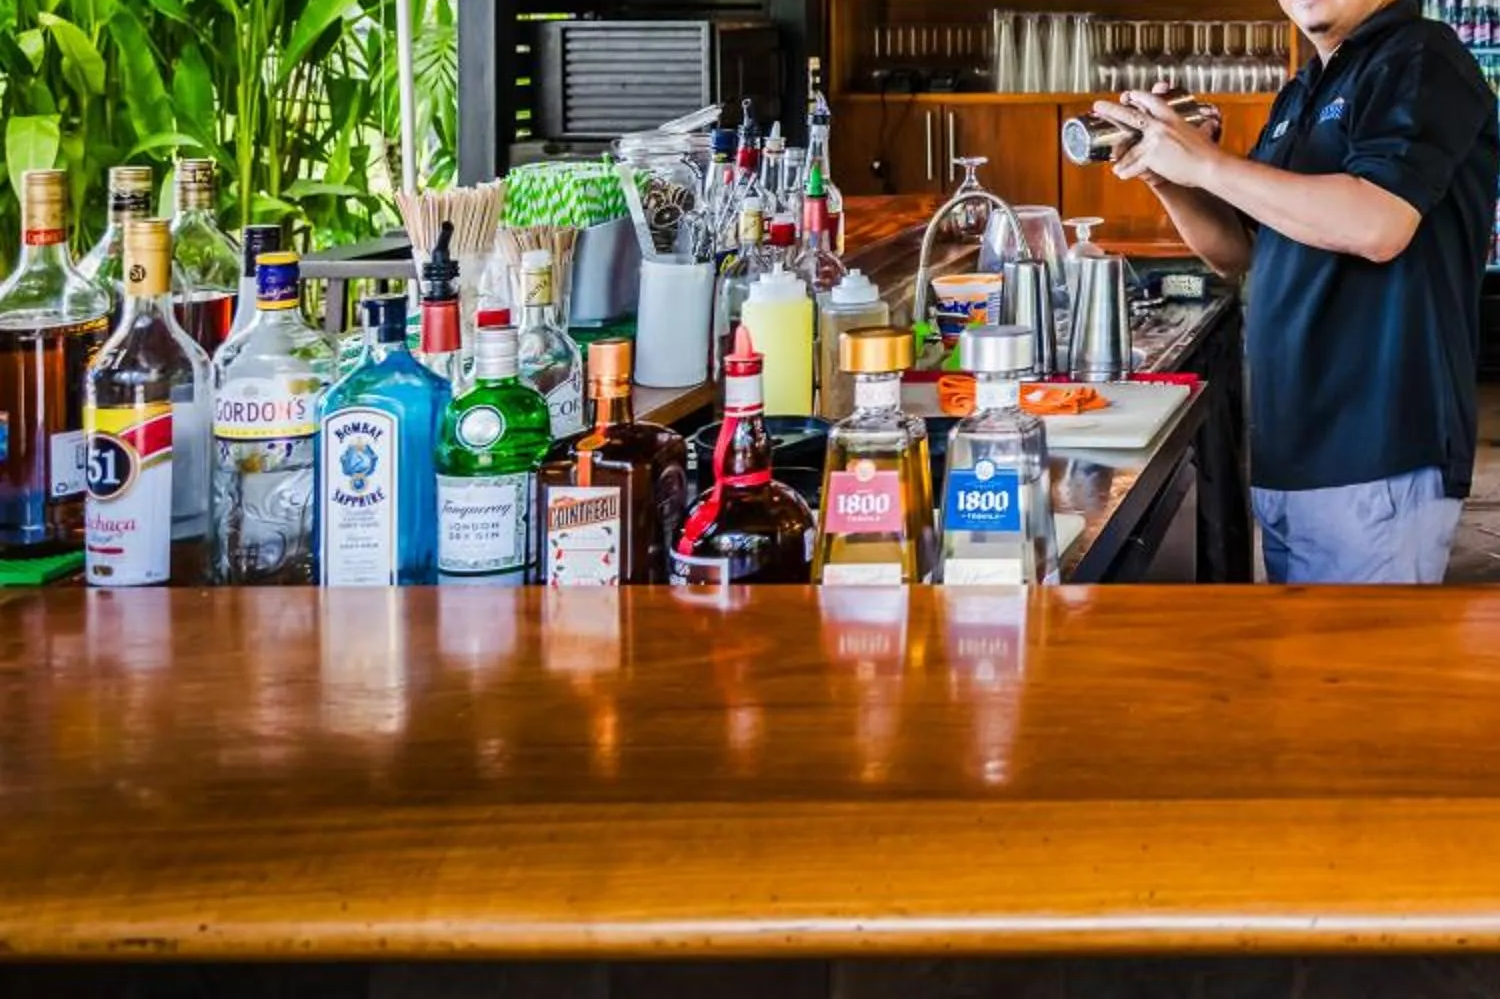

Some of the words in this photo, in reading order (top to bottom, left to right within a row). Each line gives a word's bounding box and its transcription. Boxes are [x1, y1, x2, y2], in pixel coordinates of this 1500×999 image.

[333, 421, 384, 444] BOMBAY
[88, 449, 121, 487] 51
[331, 487, 386, 508] SAPPHIRE
[440, 498, 513, 520] Tanqueray
[836, 492, 890, 515] 1800
[957, 489, 1009, 512] 1800
[551, 495, 617, 529] COINTREAU
[448, 522, 500, 531] LONDON
[448, 532, 471, 541] DRY
[475, 531, 500, 540] GIN
